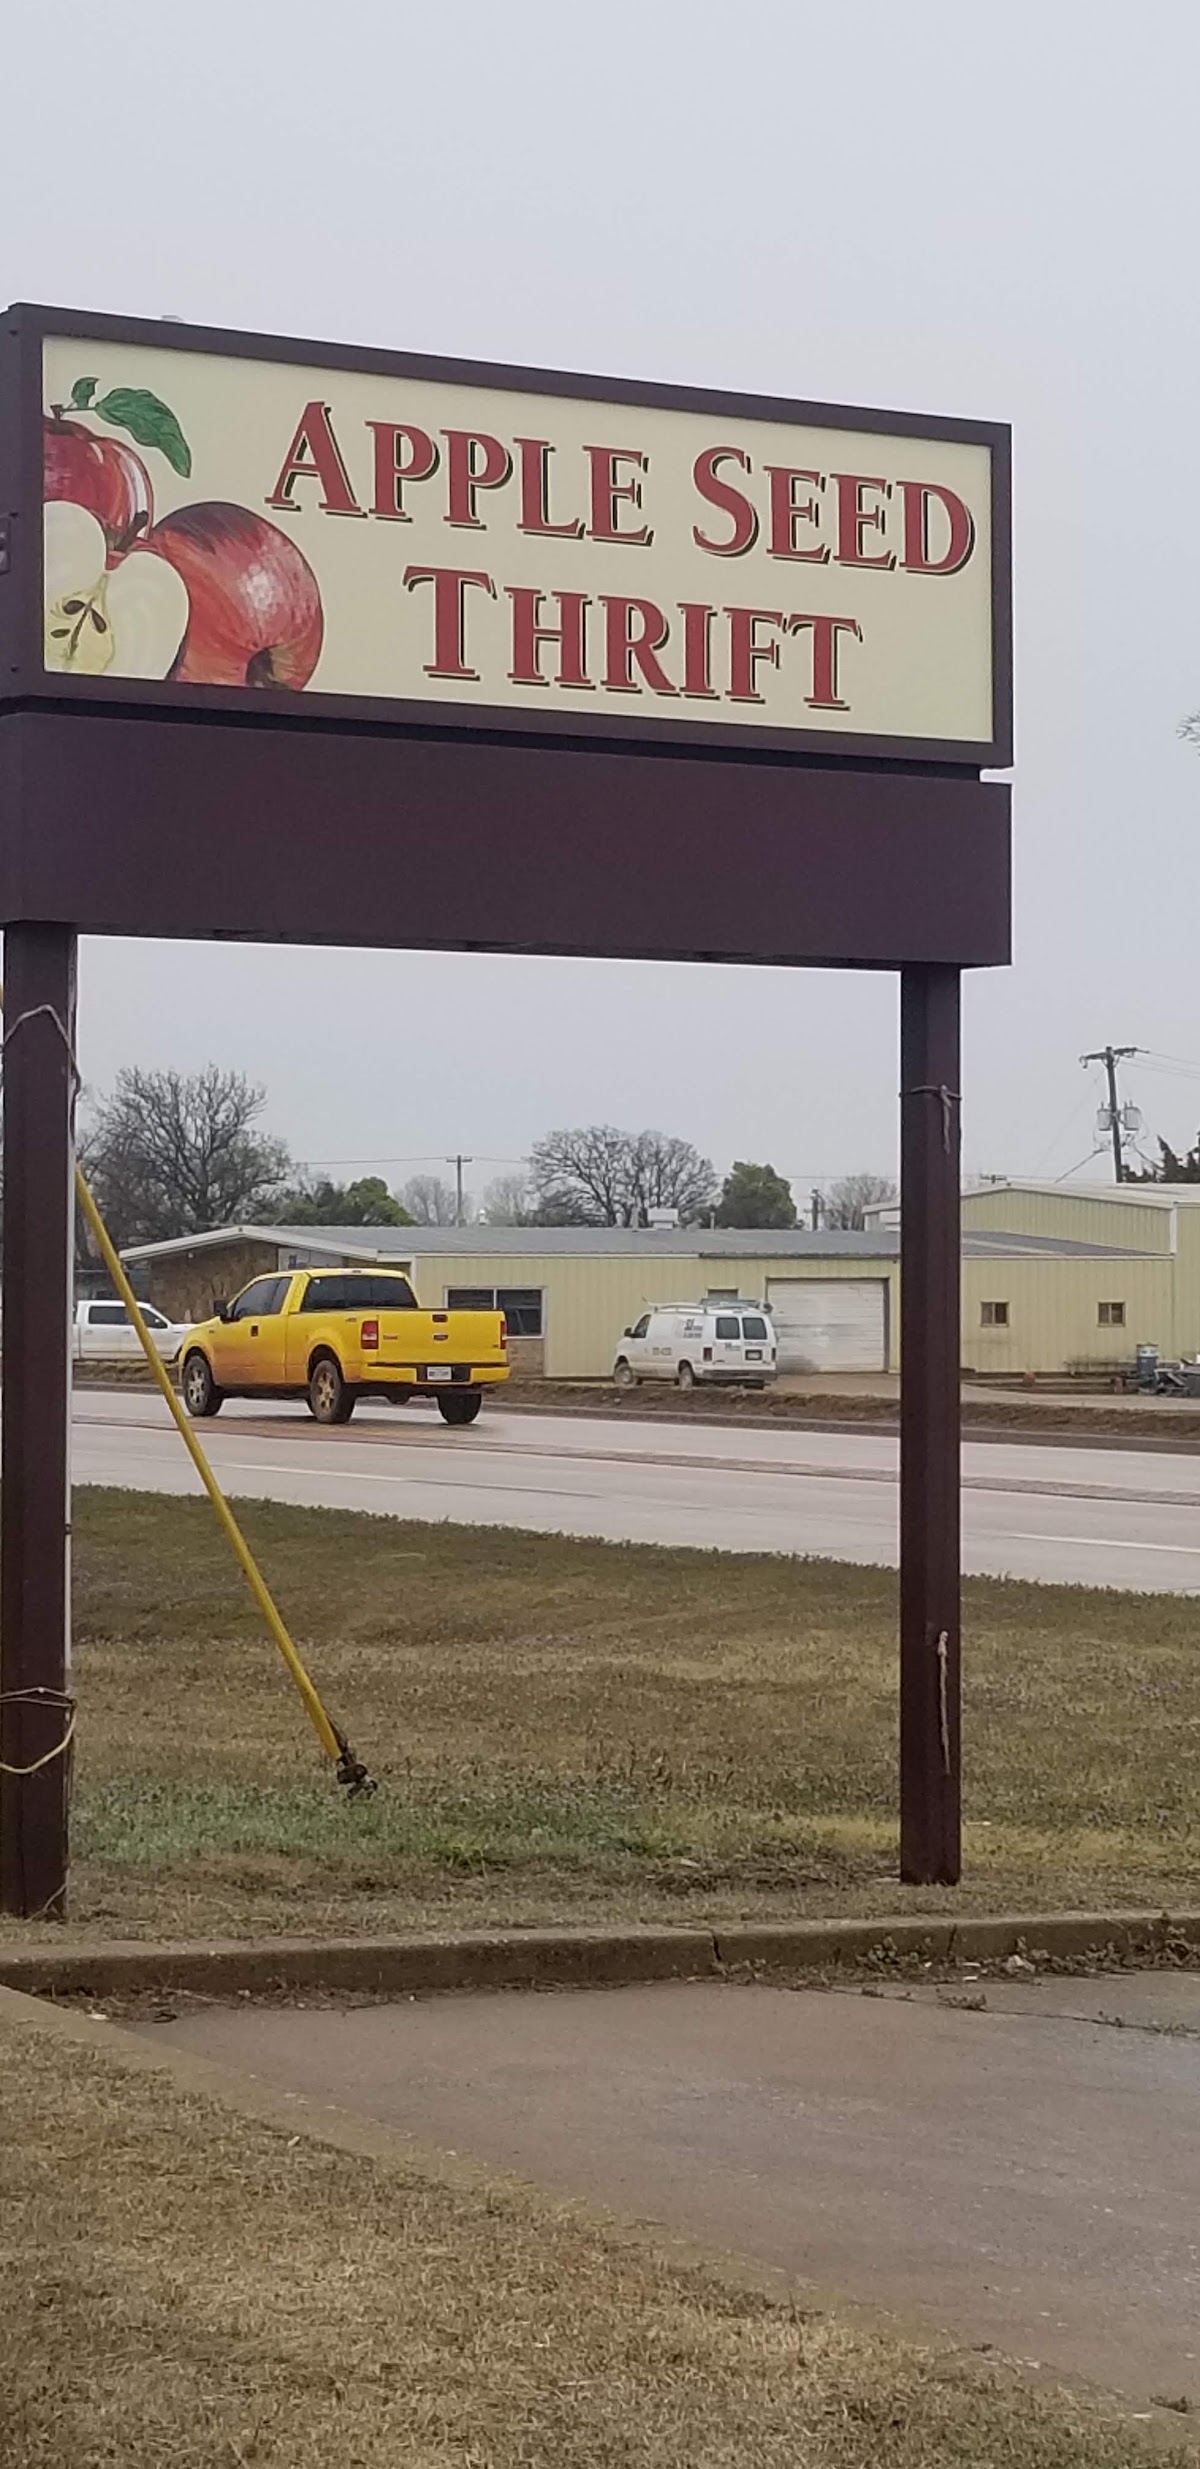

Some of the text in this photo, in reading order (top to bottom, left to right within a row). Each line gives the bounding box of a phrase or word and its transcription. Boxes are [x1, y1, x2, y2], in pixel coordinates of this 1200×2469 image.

[265, 401, 975, 575] APPLE SEED
[403, 564, 862, 711] THRIFT
